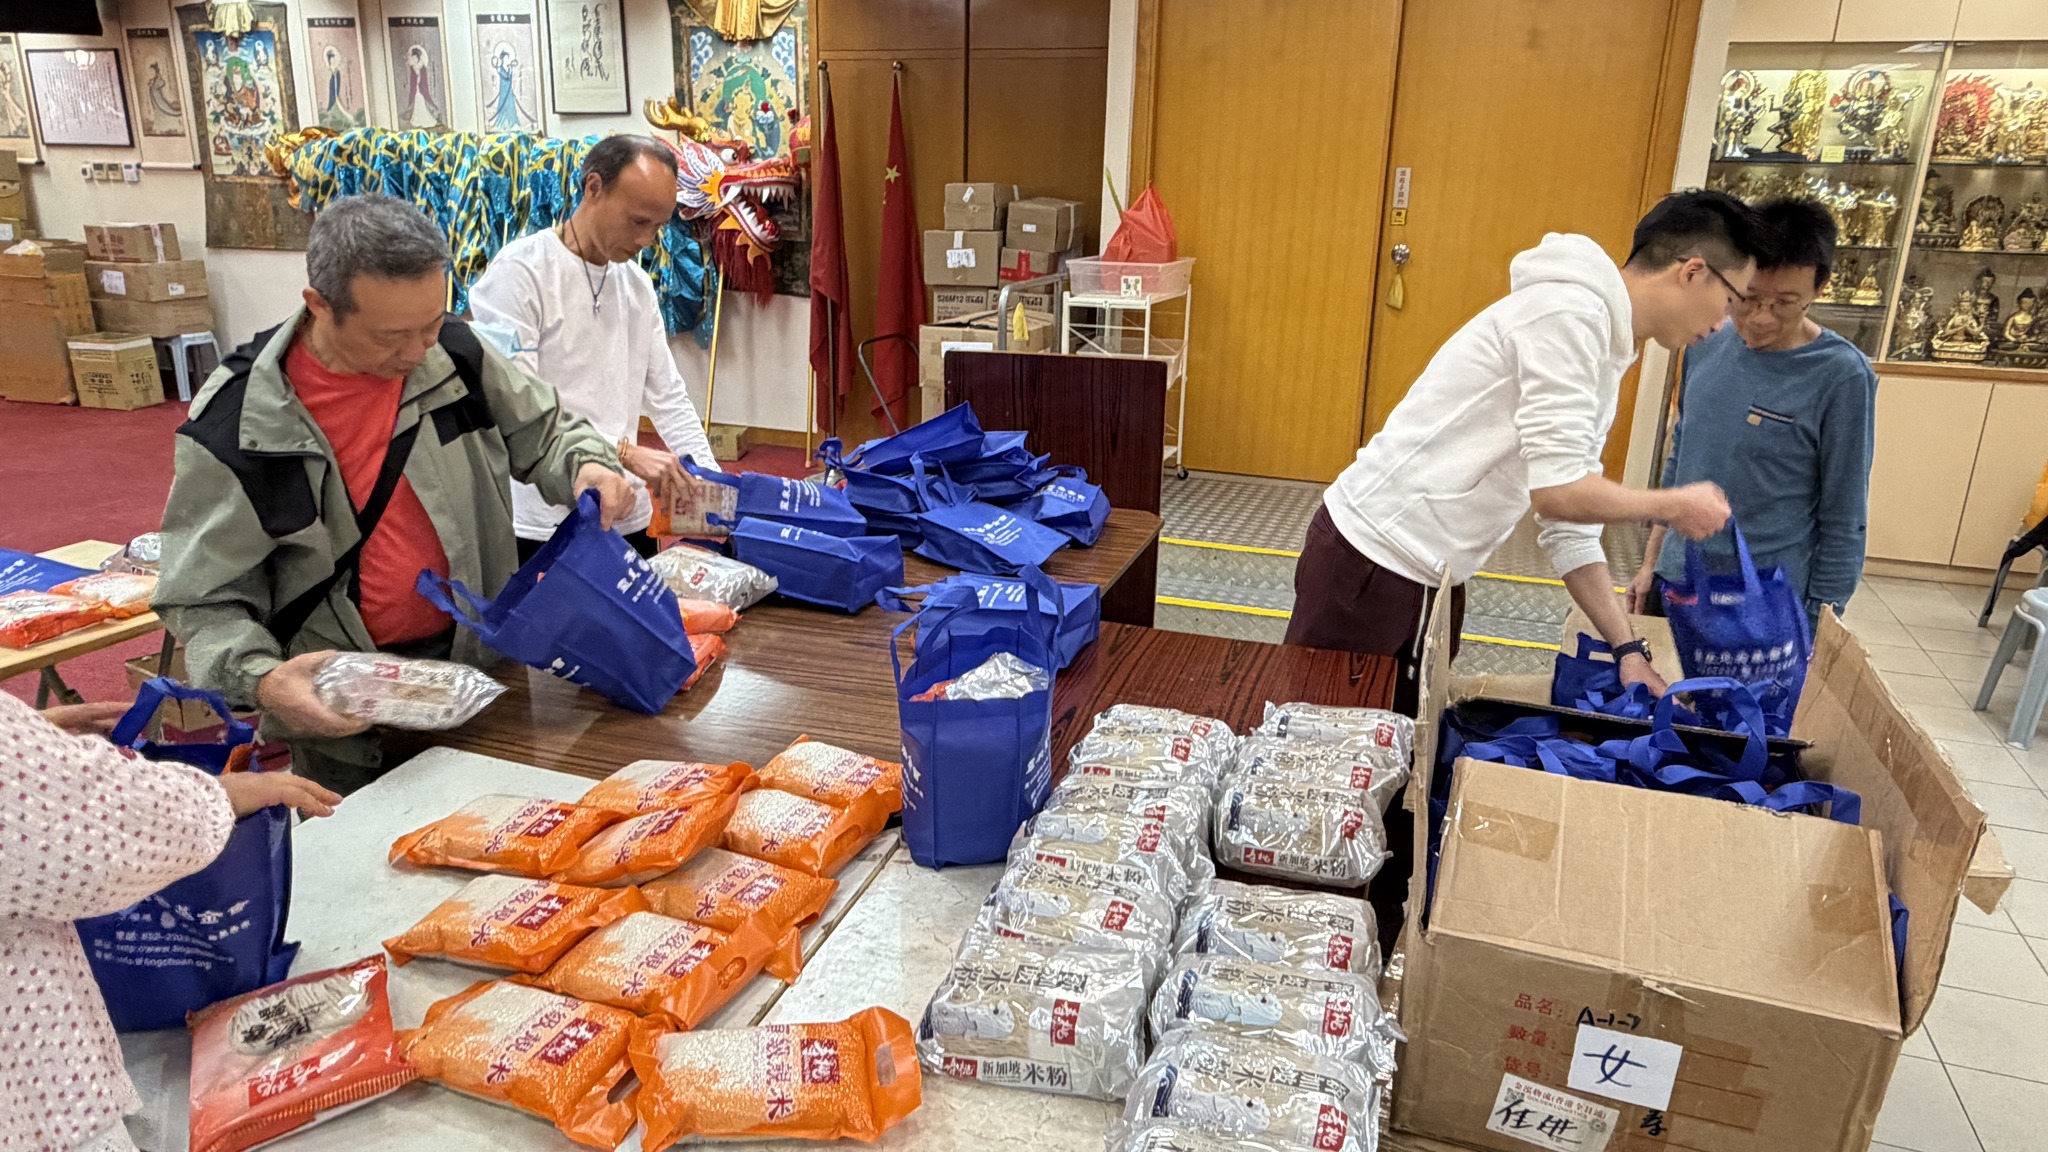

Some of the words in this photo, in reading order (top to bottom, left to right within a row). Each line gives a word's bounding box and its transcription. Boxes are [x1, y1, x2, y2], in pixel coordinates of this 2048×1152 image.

[982, 1060, 1068, 1087] 新加坡米粉
[1582, 1044, 1648, 1089] 女
